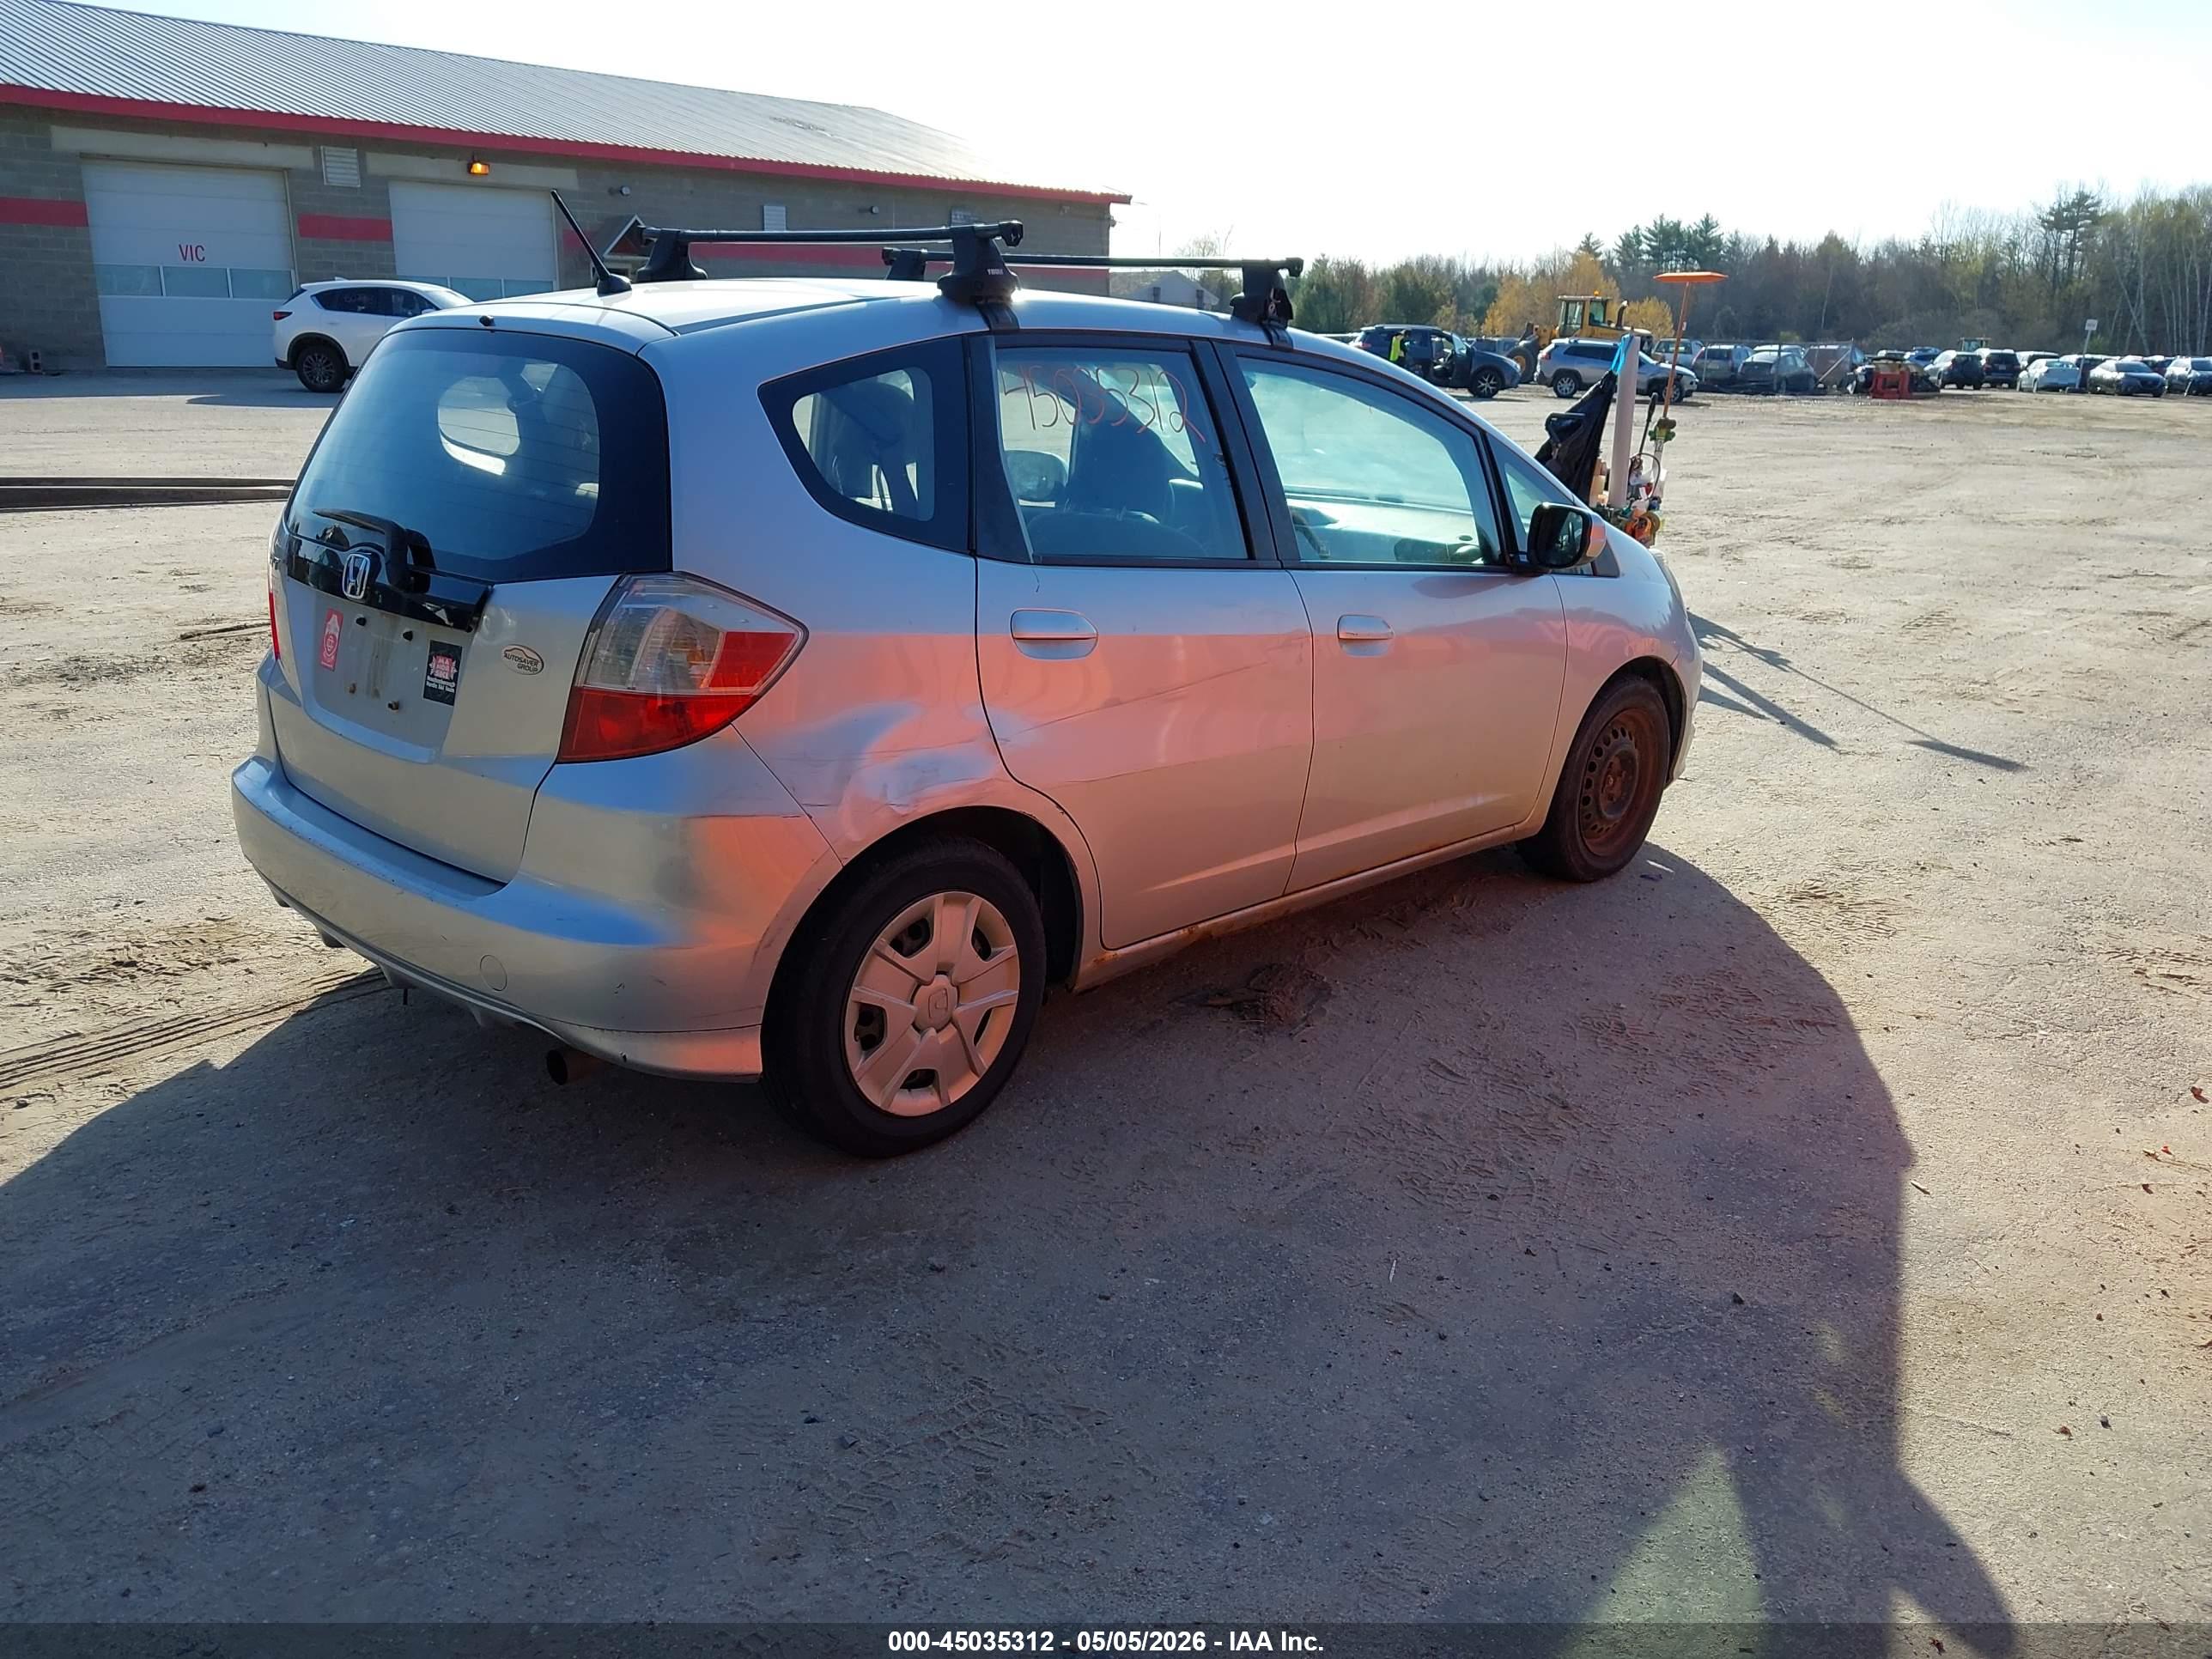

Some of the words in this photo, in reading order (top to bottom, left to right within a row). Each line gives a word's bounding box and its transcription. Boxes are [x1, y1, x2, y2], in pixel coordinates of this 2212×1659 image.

[179, 244, 205, 262] VIC
[504, 653, 539, 667] AUTOSAVER
[517, 663, 538, 672] GROUP
